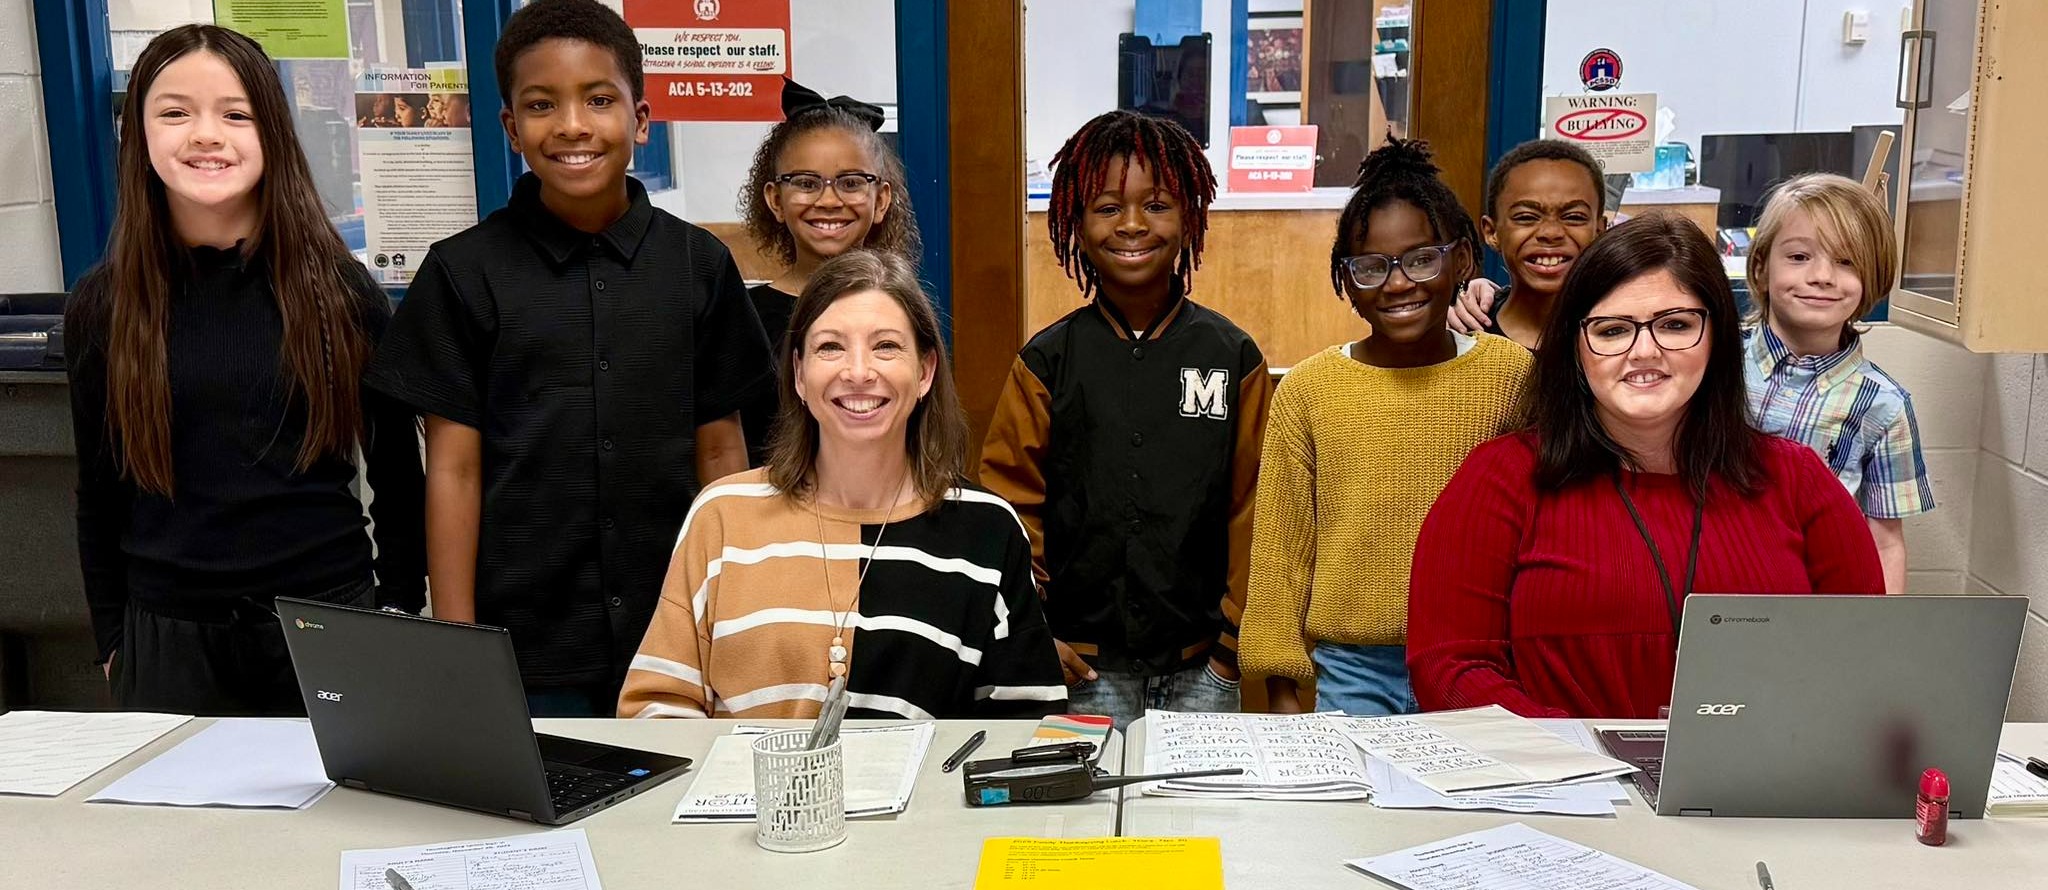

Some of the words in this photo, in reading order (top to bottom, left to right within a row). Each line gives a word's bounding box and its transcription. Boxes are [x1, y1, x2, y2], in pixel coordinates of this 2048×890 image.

[677, 45, 720, 58] respect
[727, 46, 745, 56] our
[749, 44, 780, 56] staff.
[365, 73, 432, 81] INFORMATION
[668, 82, 694, 97] ACA
[697, 82, 753, 97] 5-13-202
[1568, 97, 1637, 108] WARNING:
[1567, 118, 1635, 131] BULLYING
[1180, 368, 1228, 420] M
[317, 690, 343, 702] acer
[1697, 704, 1746, 716] acer
